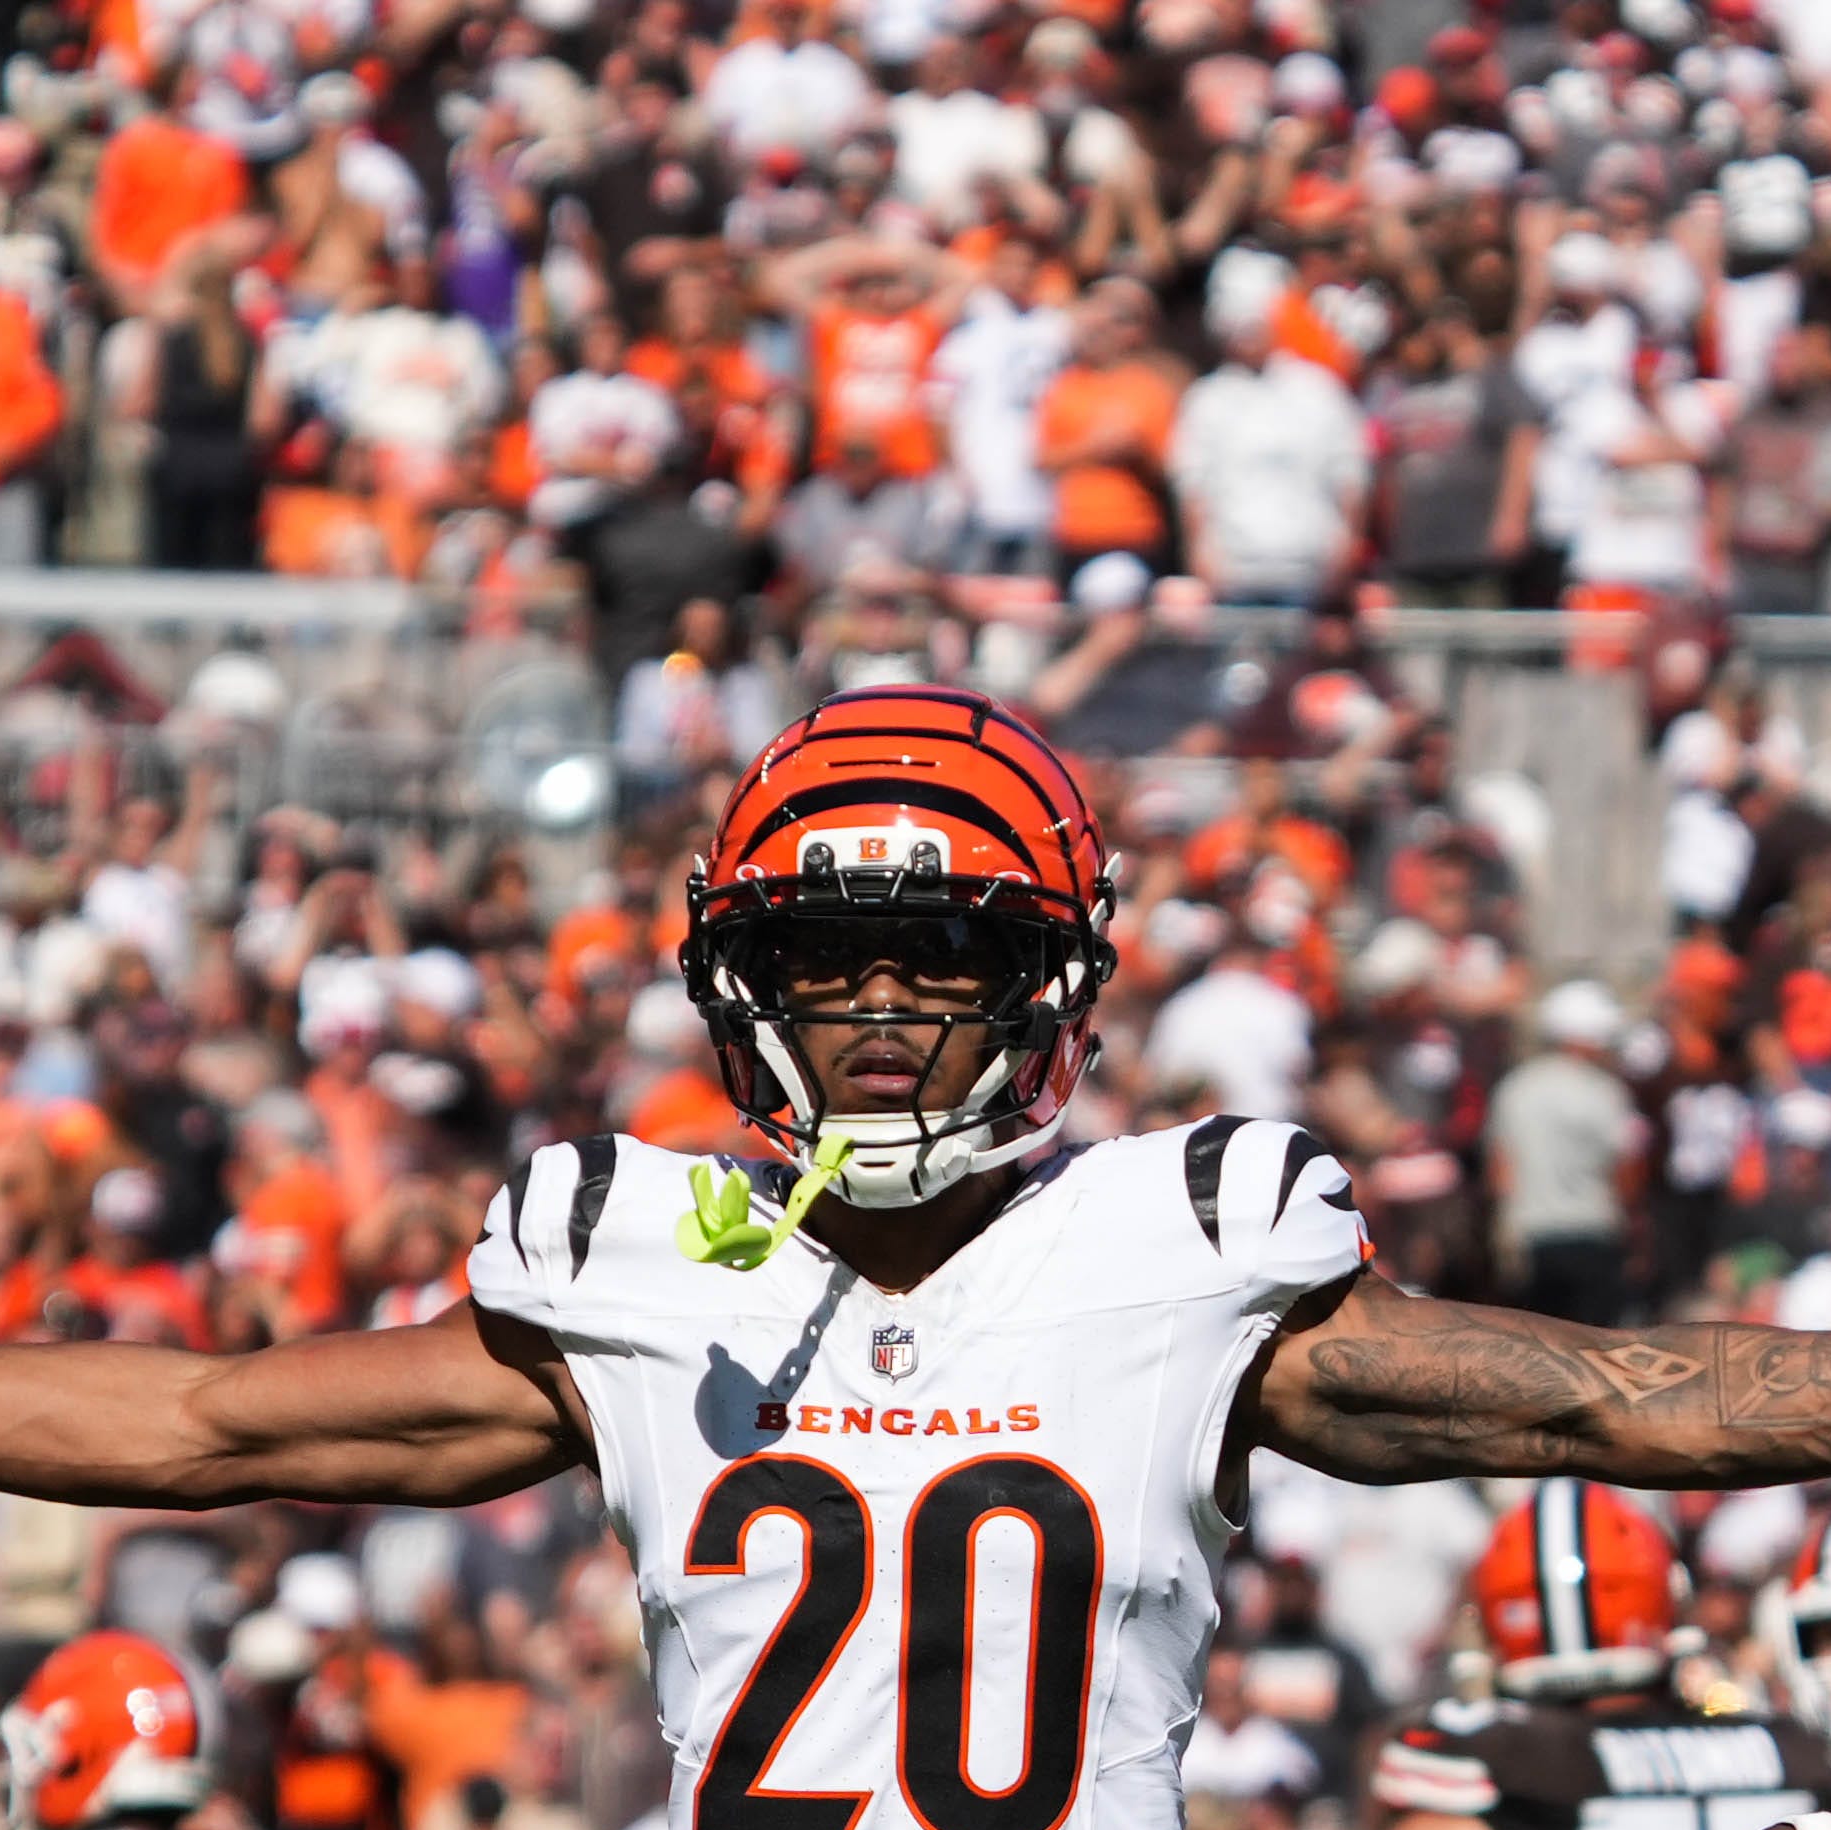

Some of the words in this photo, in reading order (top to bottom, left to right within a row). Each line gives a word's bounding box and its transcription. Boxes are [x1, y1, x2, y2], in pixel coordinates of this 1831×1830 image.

[858, 836, 889, 862] B
[876, 1347, 910, 1371] NFL
[754, 1402, 1041, 1436] BENGALS
